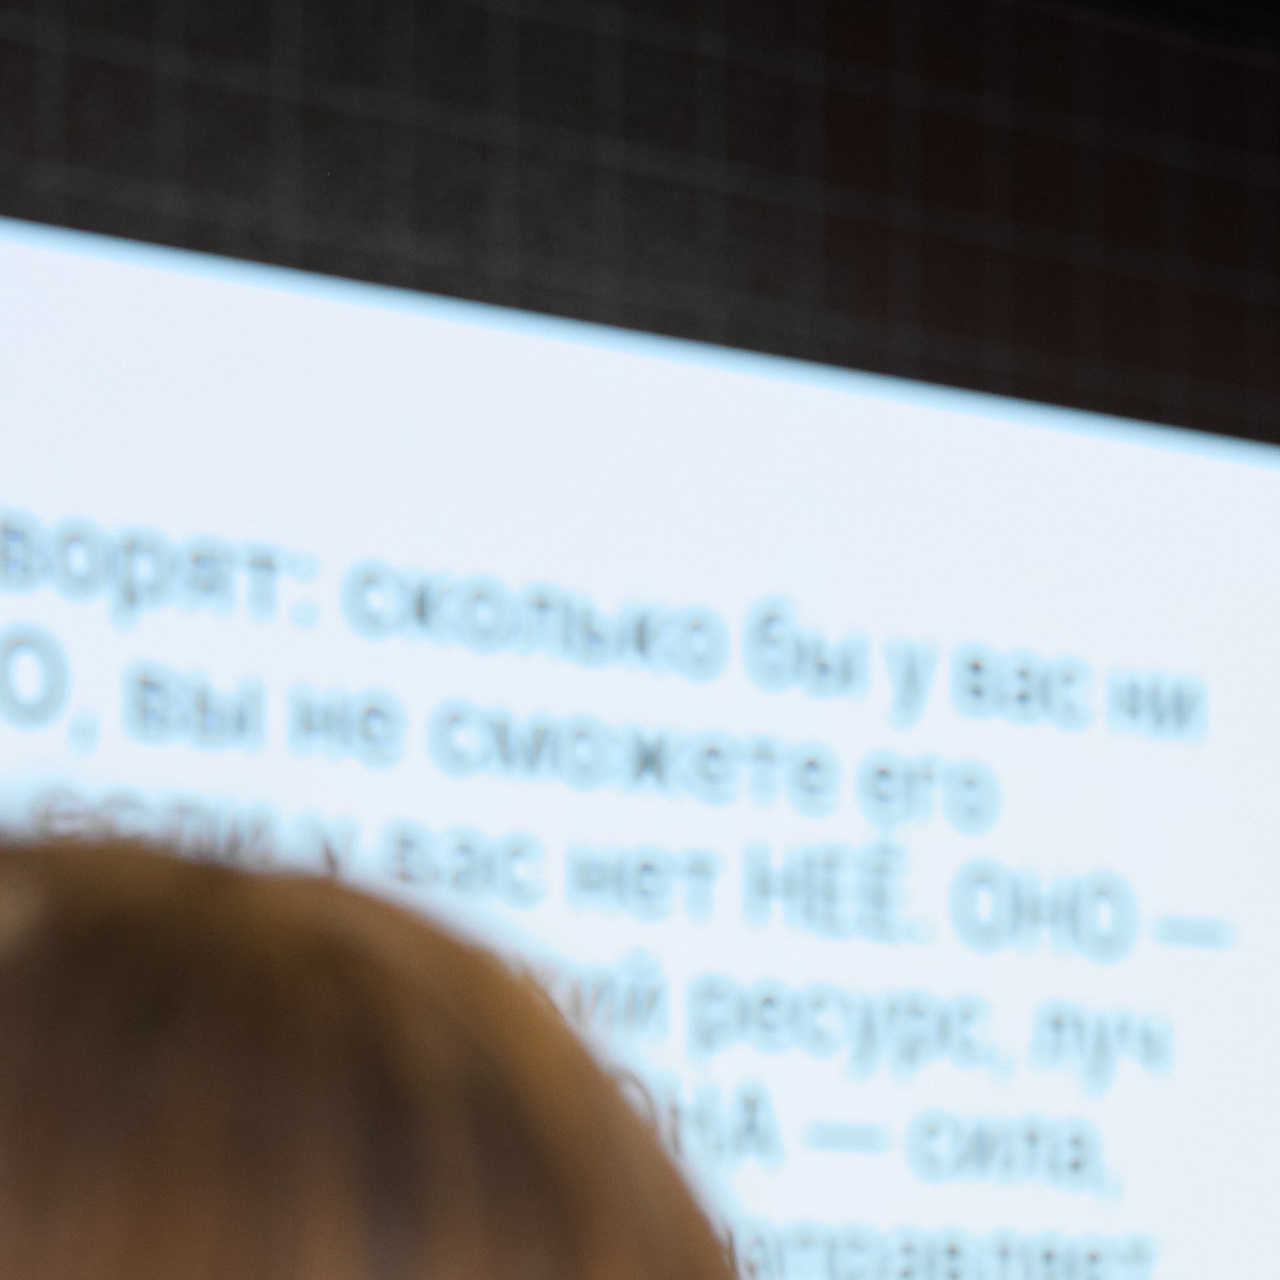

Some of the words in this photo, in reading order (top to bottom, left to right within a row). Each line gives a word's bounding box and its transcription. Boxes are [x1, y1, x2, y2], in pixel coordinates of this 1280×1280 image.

[952, 645, 1092, 730] вас
[123, 662, 266, 750] вы
[288, 685, 406, 767] не
[428, 698, 840, 815] сможете
[858, 751, 1000, 832] его
[566, 846, 720, 922] нет
[951, 860, 1139, 964] ОНО
